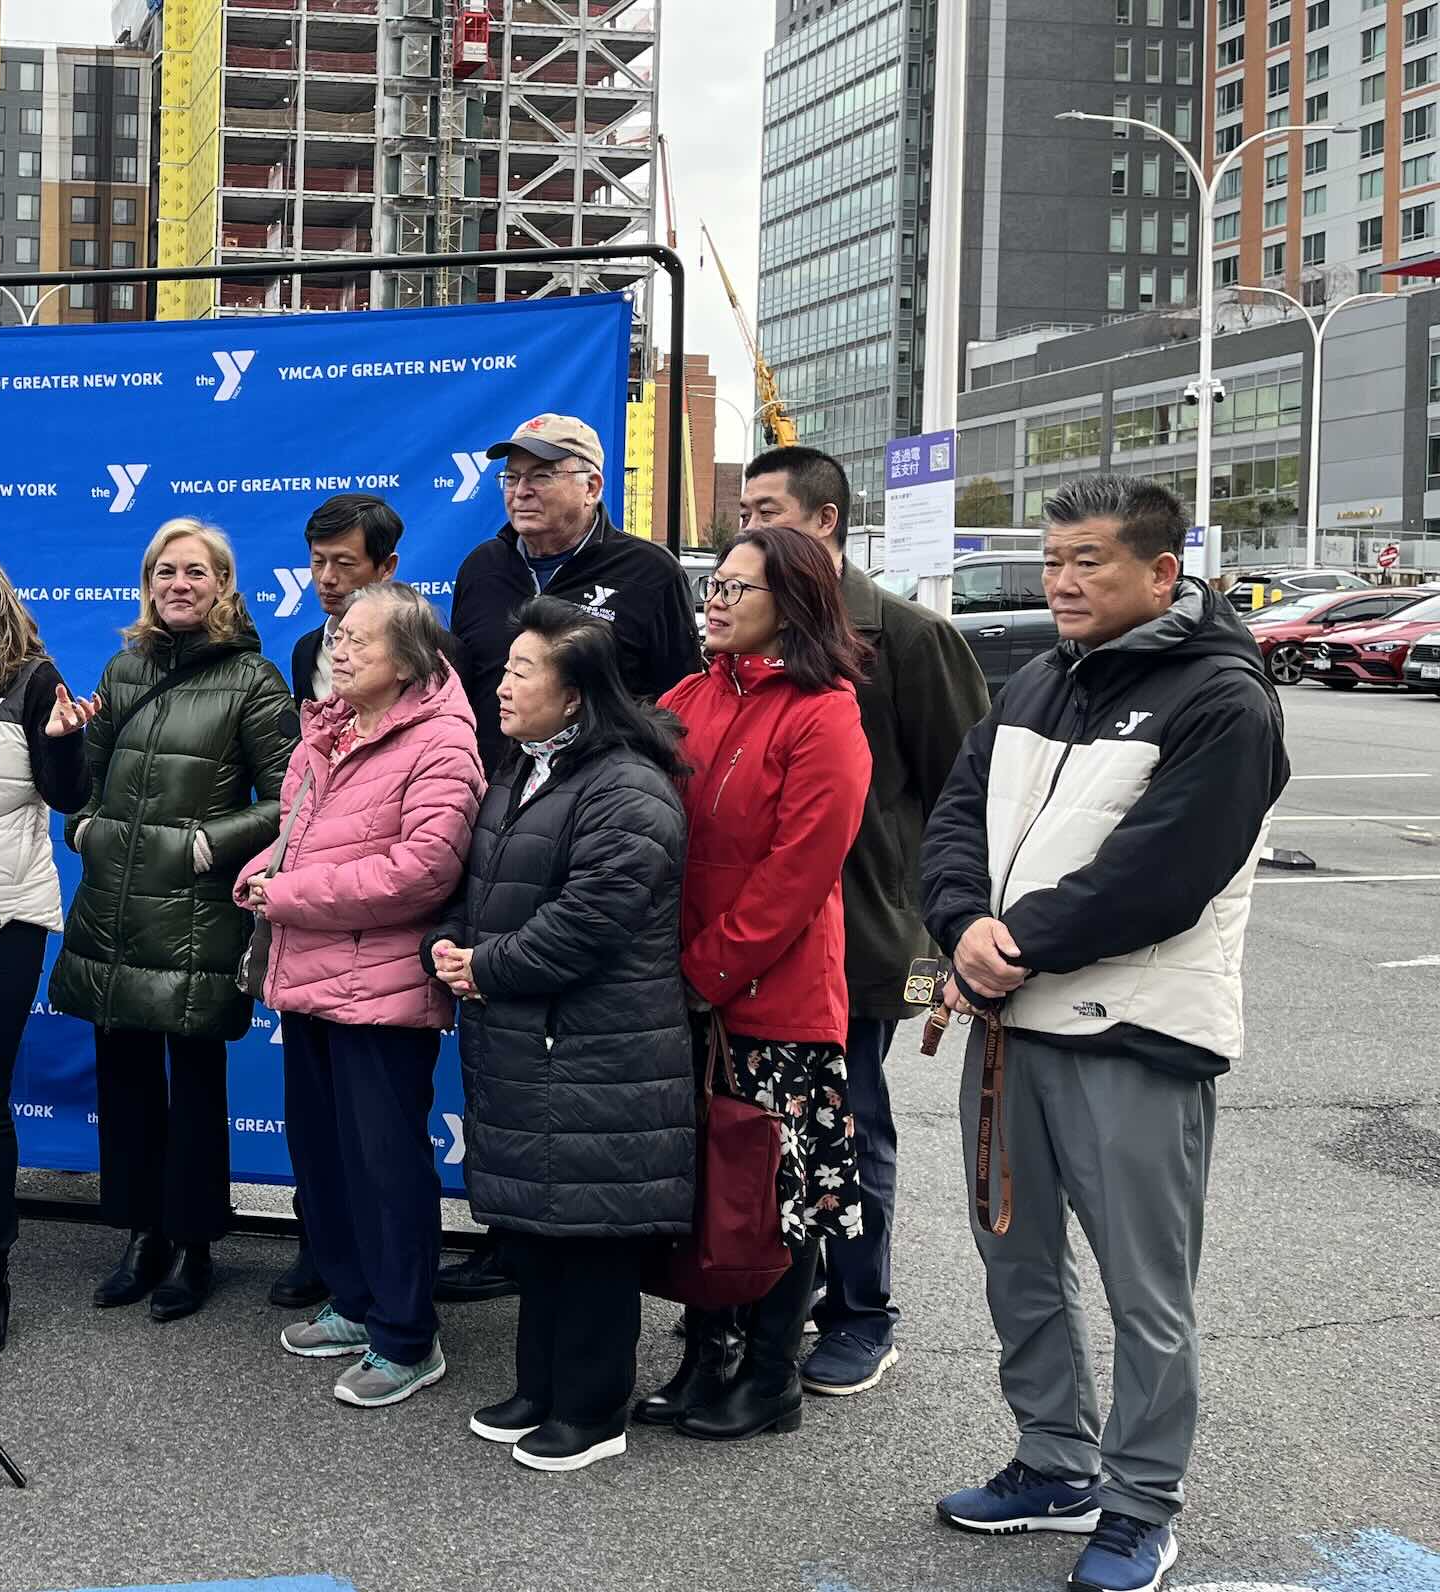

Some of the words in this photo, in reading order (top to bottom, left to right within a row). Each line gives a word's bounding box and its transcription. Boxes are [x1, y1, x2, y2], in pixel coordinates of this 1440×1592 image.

[278, 366, 324, 381] YMCA
[327, 364, 348, 379] OF
[351, 360, 425, 378] GREATER
[429, 357, 467, 373] NEW
[471, 354, 517, 371] YORK
[13, 375, 79, 390] GREATER
[83, 373, 117, 387] NEW
[121, 372, 163, 387] YORK
[195, 374, 216, 387] the
[170, 480, 213, 494] YMCA
[217, 479, 237, 493] OF
[241, 477, 312, 492] GREATER
[316, 475, 352, 490] NEW
[356, 474, 400, 488] YORK
[433, 476, 455, 488] the
[15, 483, 57, 497] YORK
[91, 486, 110, 498] the
[53, 588, 72, 601] OF
[74, 587, 141, 601] GREATER
[414, 581, 456, 595] GREA
[256, 591, 277, 602] the
[251, 1016, 271, 1028] the
[13, 1104, 54, 1118] YORK
[87, 1113, 99, 1124] th
[235, 1118, 285, 1134] GREAT
[431, 1136, 446, 1148] he
